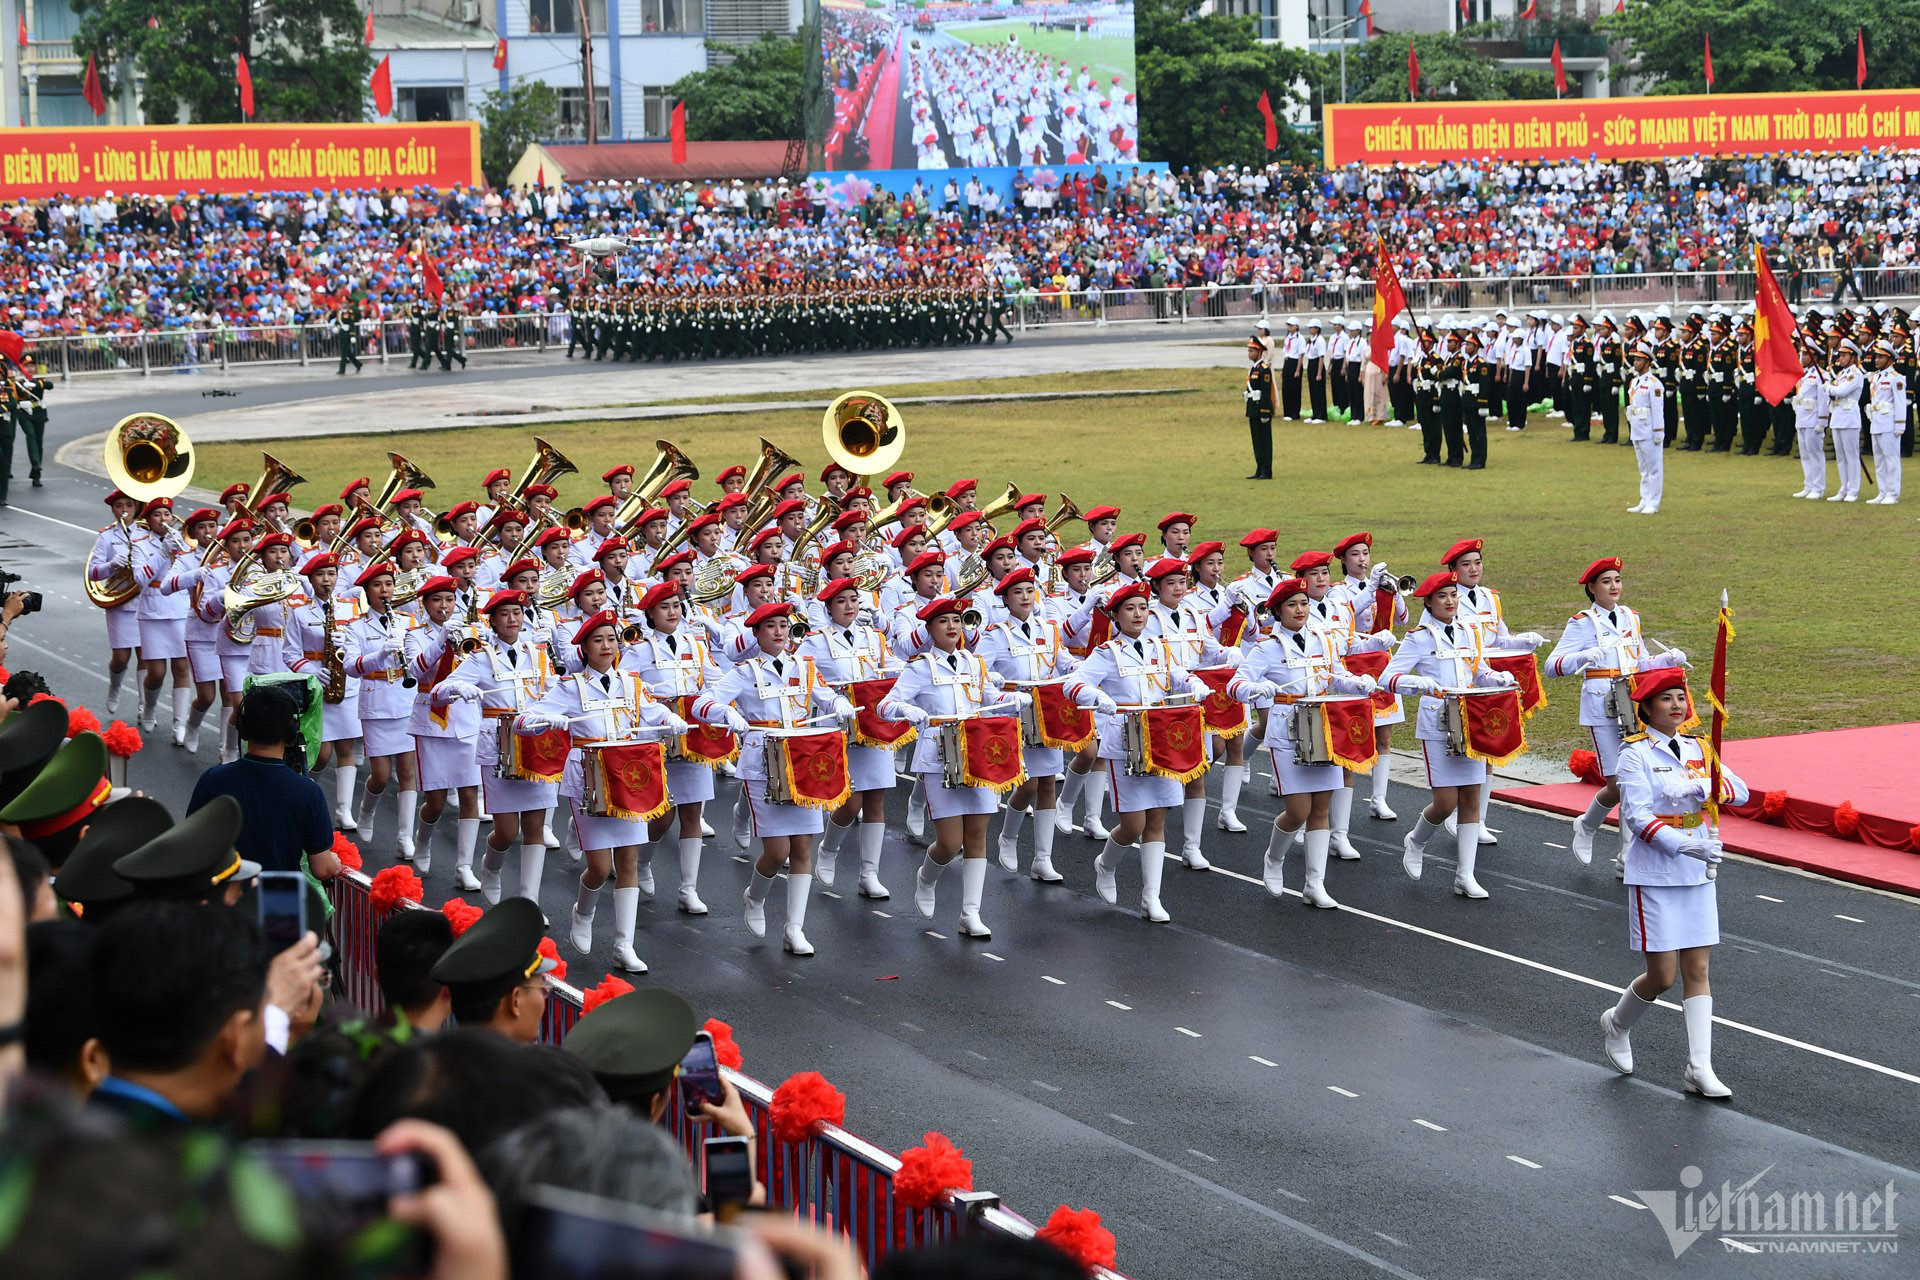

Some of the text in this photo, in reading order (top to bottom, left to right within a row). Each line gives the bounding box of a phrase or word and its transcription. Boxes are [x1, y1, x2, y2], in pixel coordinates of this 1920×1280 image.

[1364, 116, 1412, 152] CHIẾN
[1416, 114, 1469, 150] THẮNG
[1472, 117, 1510, 155] ĐIỆN
[1514, 117, 1551, 149] BIÊN
[1555, 112, 1588, 147] PHỦ
[1604, 115, 1636, 146] SỨC
[1640, 118, 1689, 149] MẠNH
[1693, 111, 1727, 147] VIỆT
[1731, 114, 1769, 141] NAM
[1773, 108, 1810, 140] THỜI
[1814, 112, 1842, 145] ĐẠI
[1846, 104, 1869, 138] HỒ
[1873, 105, 1900, 137] CHÍ
[4, 147, 43, 184] BIÊN
[46, 143, 79, 184] PHỦ
[94, 146, 137, 182] LỪNG
[140, 139, 169, 181] LẪY
[174, 144, 212, 180] NĂM
[216, 143, 265, 182] CHÂU,
[268, 138, 312, 178] CHẤN
[316, 142, 360, 184] ĐỘNG
[364, 147, 393, 183] ĐỊA
